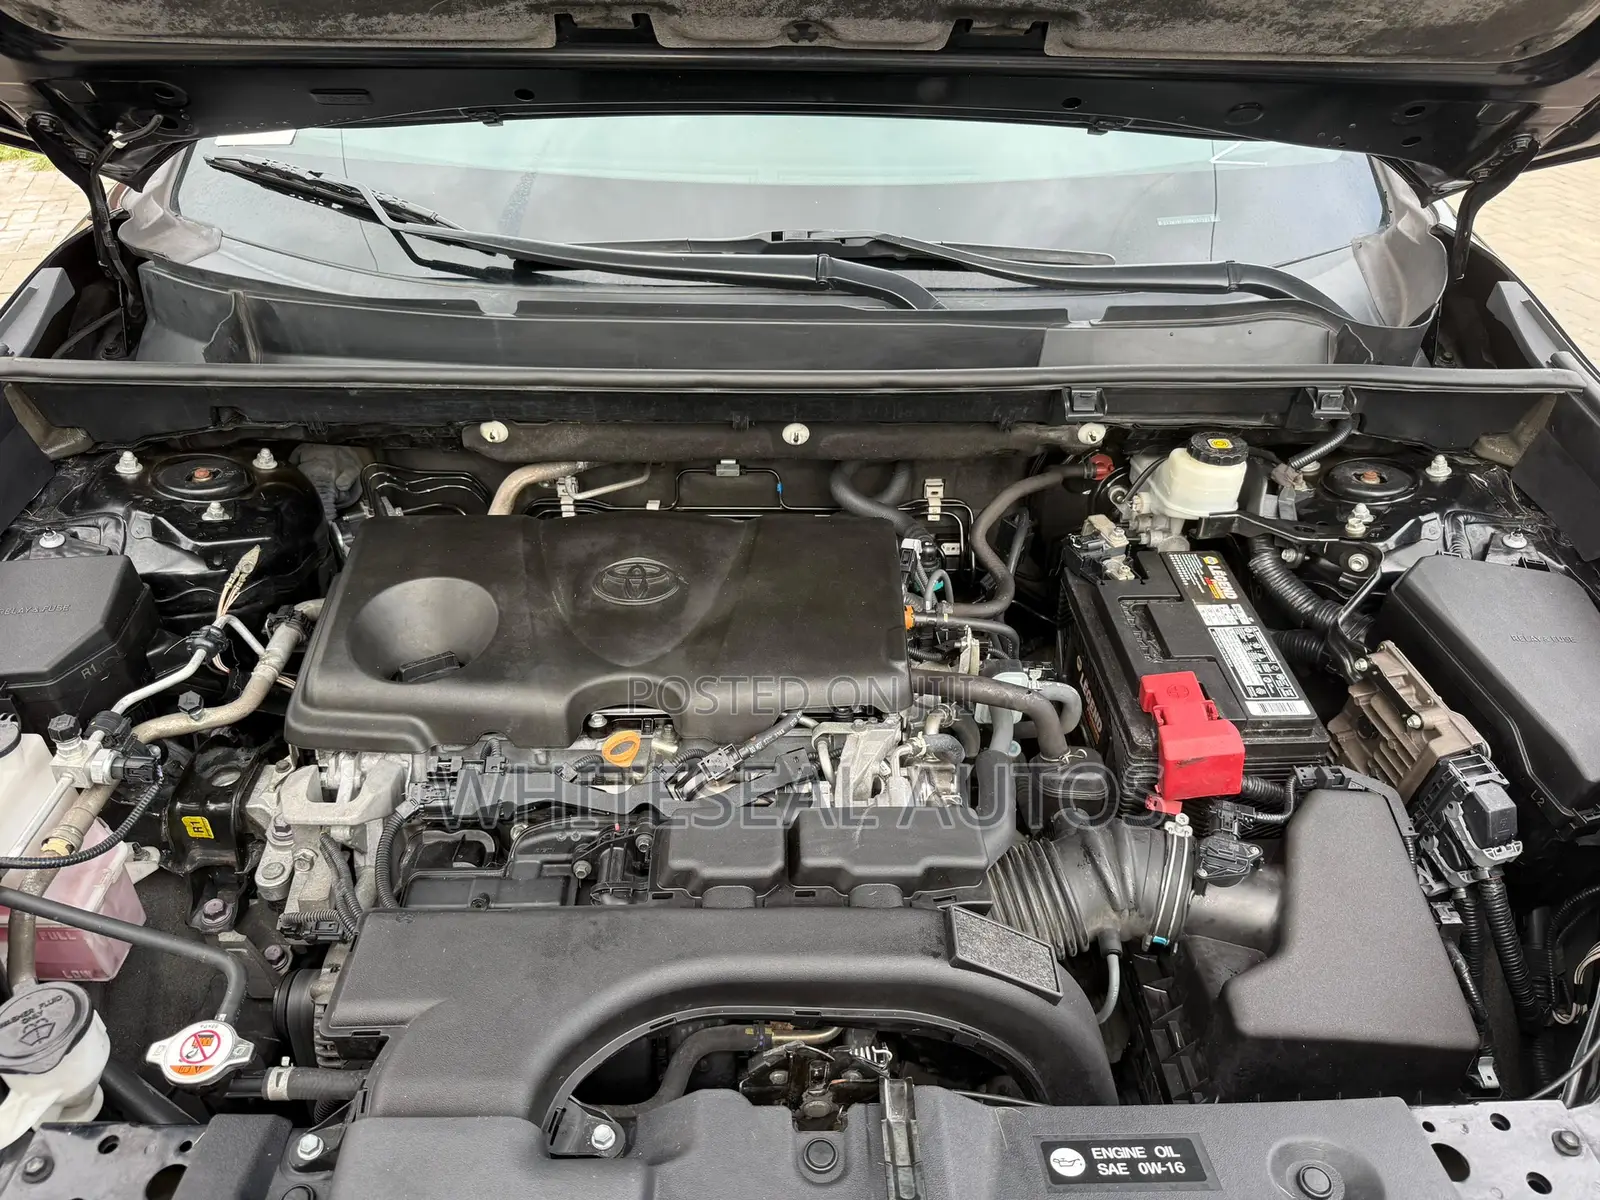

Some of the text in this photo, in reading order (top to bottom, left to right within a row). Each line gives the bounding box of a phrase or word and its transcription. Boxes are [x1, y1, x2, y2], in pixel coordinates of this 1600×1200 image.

[1208, 565, 1238, 599] LEGEND
[41, 604, 71, 613] FUSE
[81, 663, 97, 679] R1
[1080, 672, 1102, 733] LEGEND
[1530, 789, 1545, 808] L2
[39, 931, 77, 941] FULL
[62, 969, 93, 979] LOW
[39, 994, 63, 1010] FLUID
[22, 1010, 44, 1025] ONLY
[1091, 1145, 1181, 1159] ENGINE OIL
[1097, 1161, 1186, 1176] SAE 0W-16
